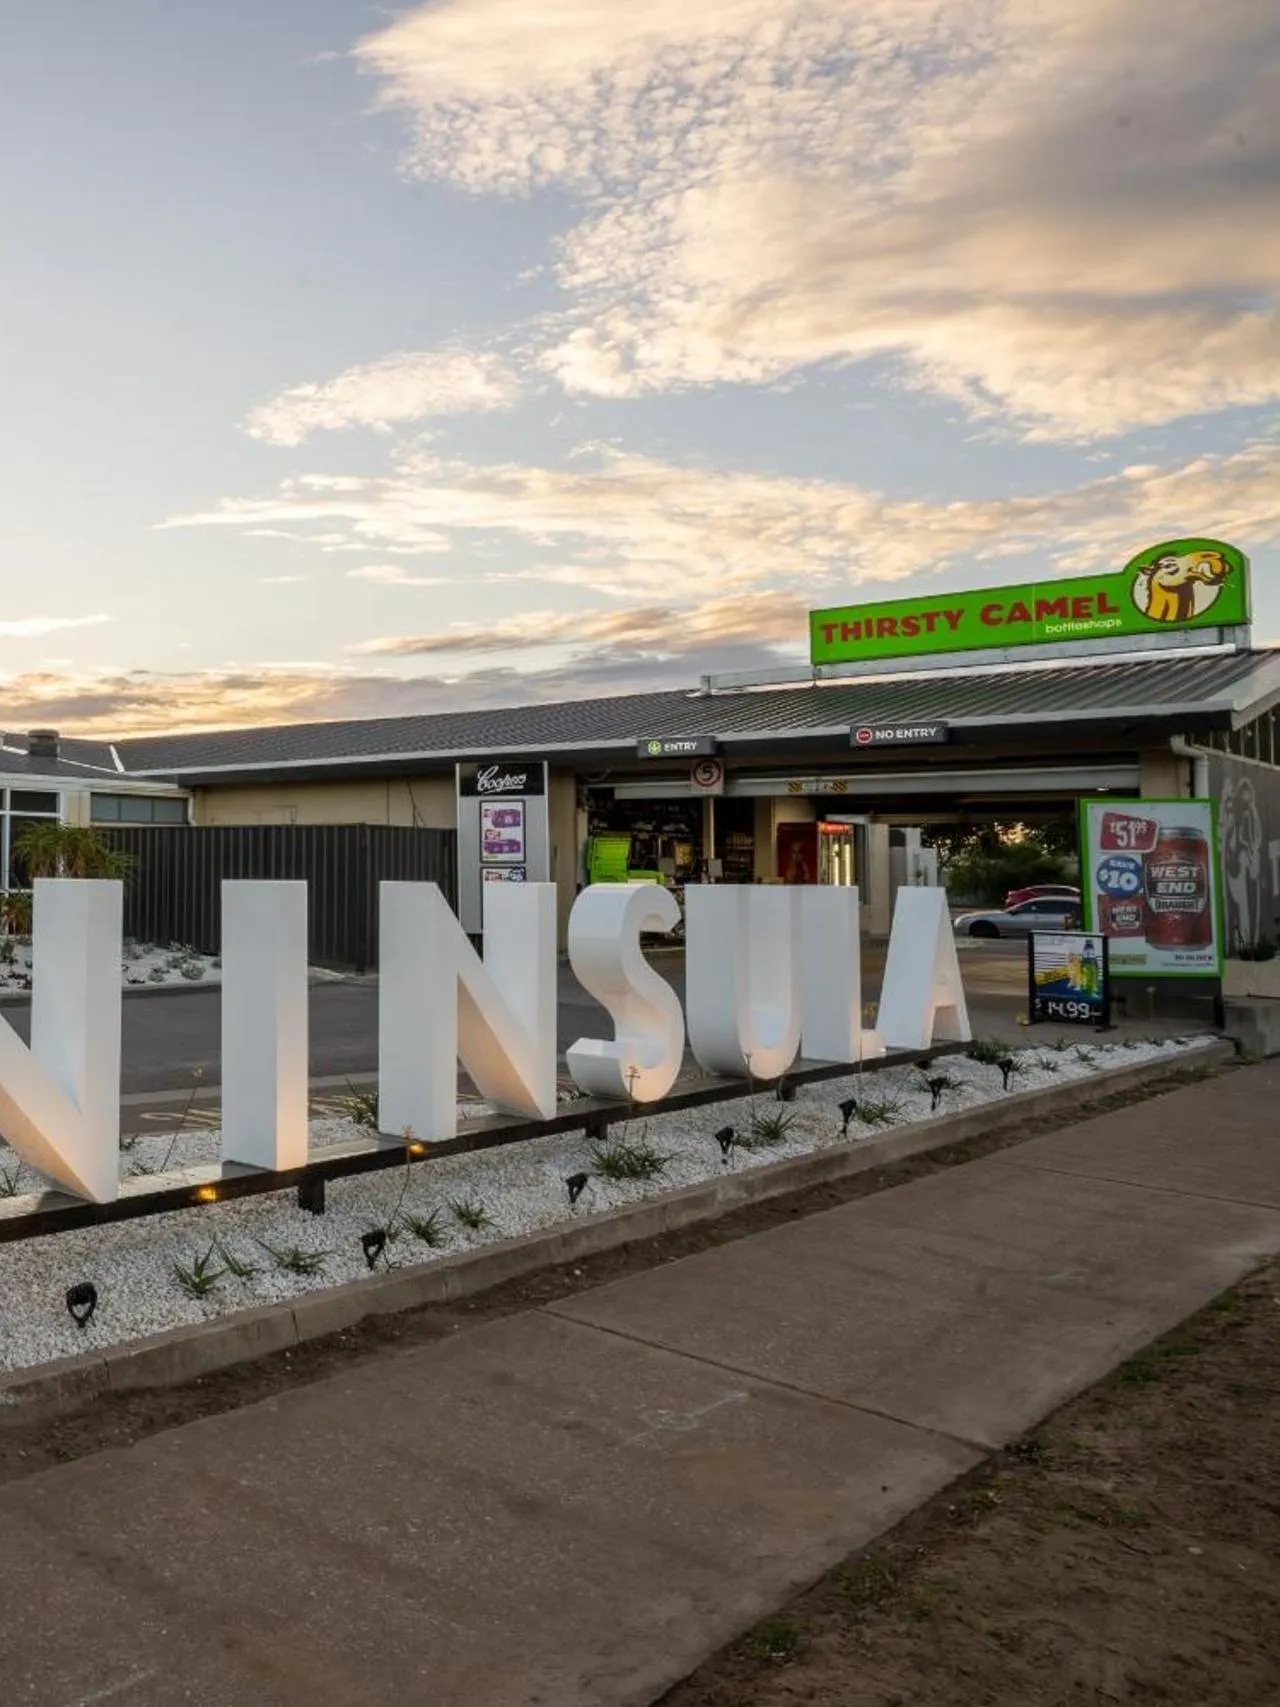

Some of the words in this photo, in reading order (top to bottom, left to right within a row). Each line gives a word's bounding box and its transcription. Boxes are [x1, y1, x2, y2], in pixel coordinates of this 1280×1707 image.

[821, 609, 965, 645] THIRSTY
[980, 592, 1119, 627] CAMEL
[1045, 618, 1122, 634] bottleshops
[875, 730, 894, 740] NO
[896, 727, 937, 738] ENTRY
[664, 742, 697, 752] ENTRY
[477, 765, 527, 793] Coopers
[1150, 866, 1200, 878] WEST
[1099, 868, 1139, 891] $10
[1156, 882, 1197, 893] END
